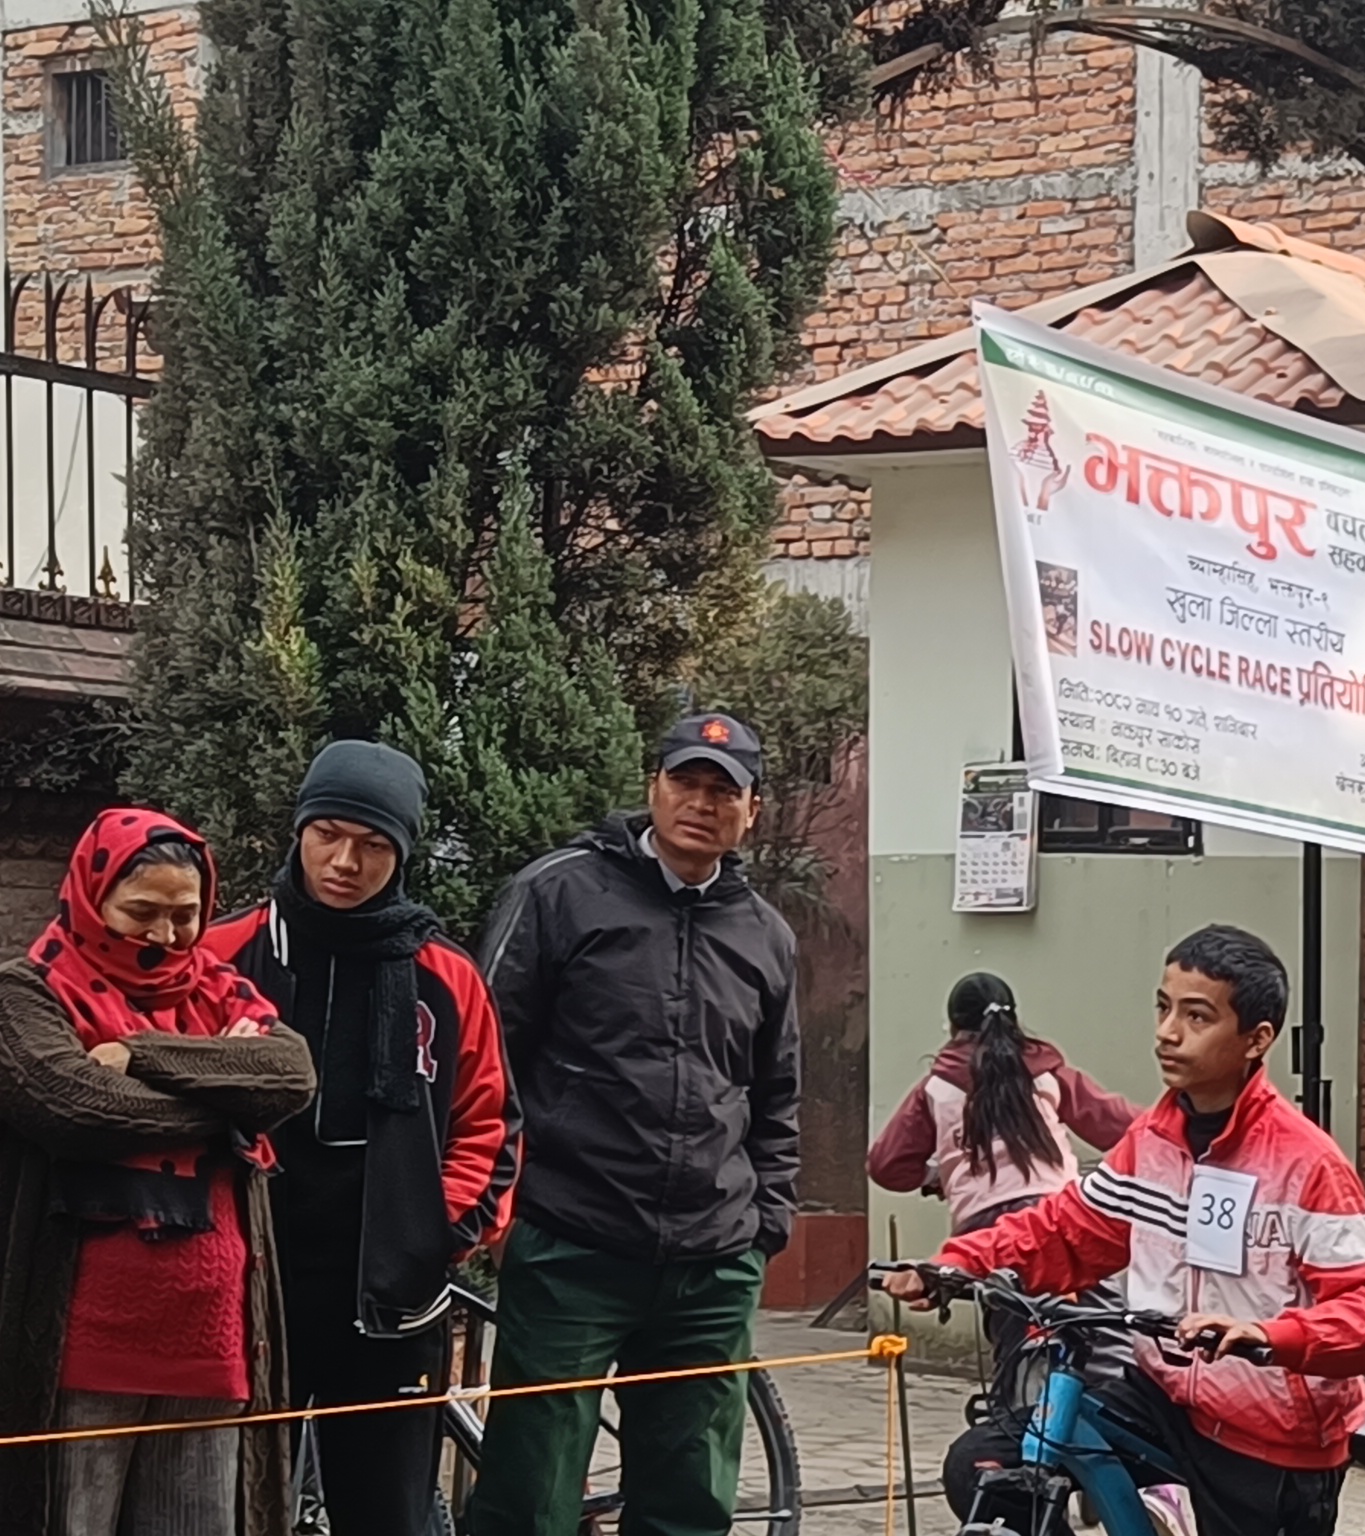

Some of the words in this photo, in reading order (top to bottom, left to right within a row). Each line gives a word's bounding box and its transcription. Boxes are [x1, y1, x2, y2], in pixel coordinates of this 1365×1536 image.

[1084, 432, 1317, 560] भक्तपुर
[1165, 586, 1213, 624] खुला
[1219, 595, 1279, 639] जिल्ला
[1285, 618, 1346, 655] स्तरीय
[1089, 619, 1154, 666] SLOW
[1160, 637, 1231, 684] CYCLE
[1238, 655, 1292, 698] RACE
[1197, 1193, 1236, 1230] 38
